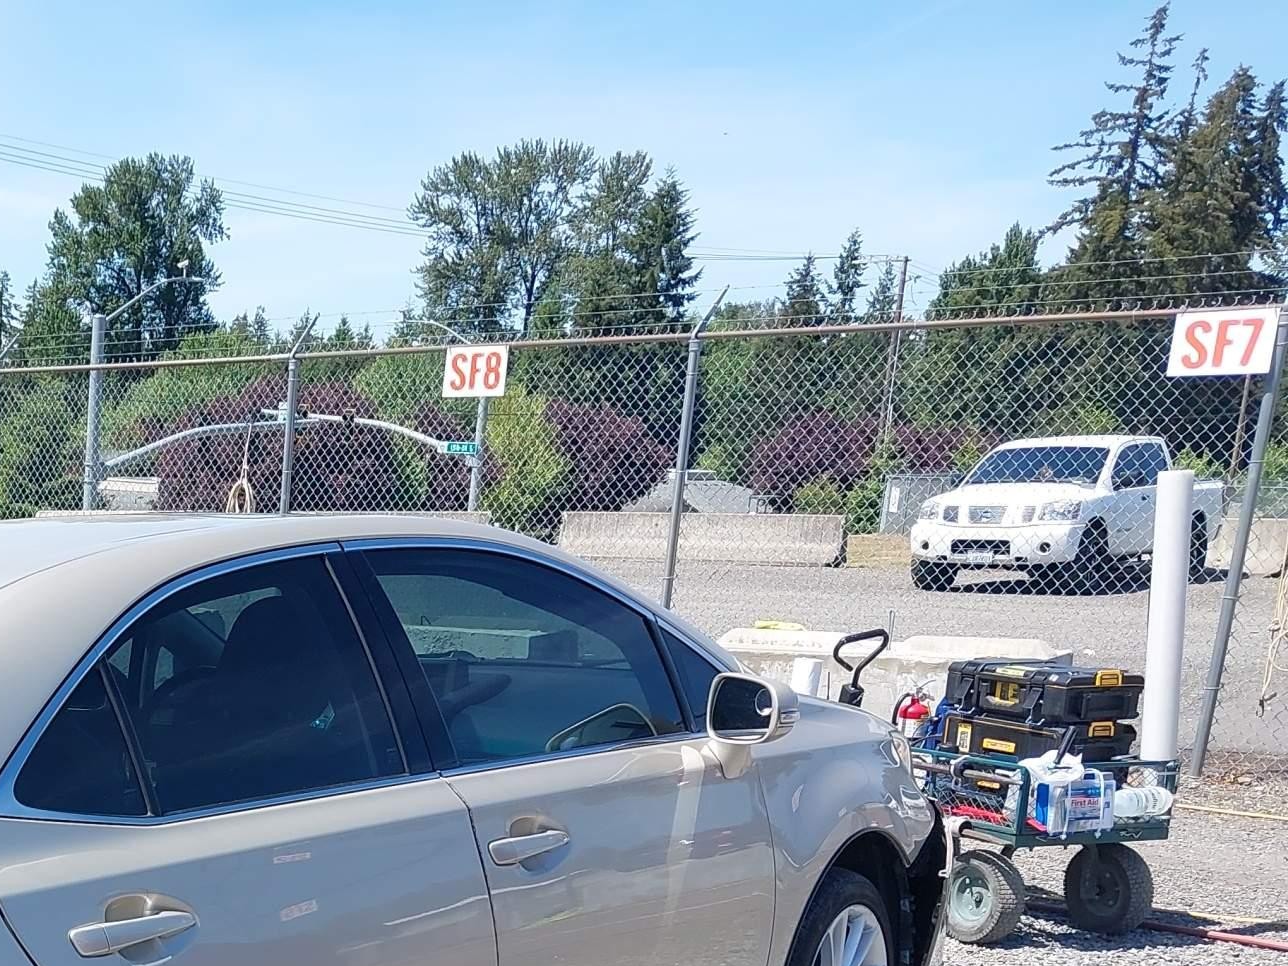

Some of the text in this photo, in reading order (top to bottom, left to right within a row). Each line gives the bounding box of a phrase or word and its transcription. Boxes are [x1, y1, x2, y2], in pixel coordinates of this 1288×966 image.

[1181, 318, 1264, 369] SF7
[450, 352, 502, 391] SF8
[1071, 799, 1099, 808] First Aid
